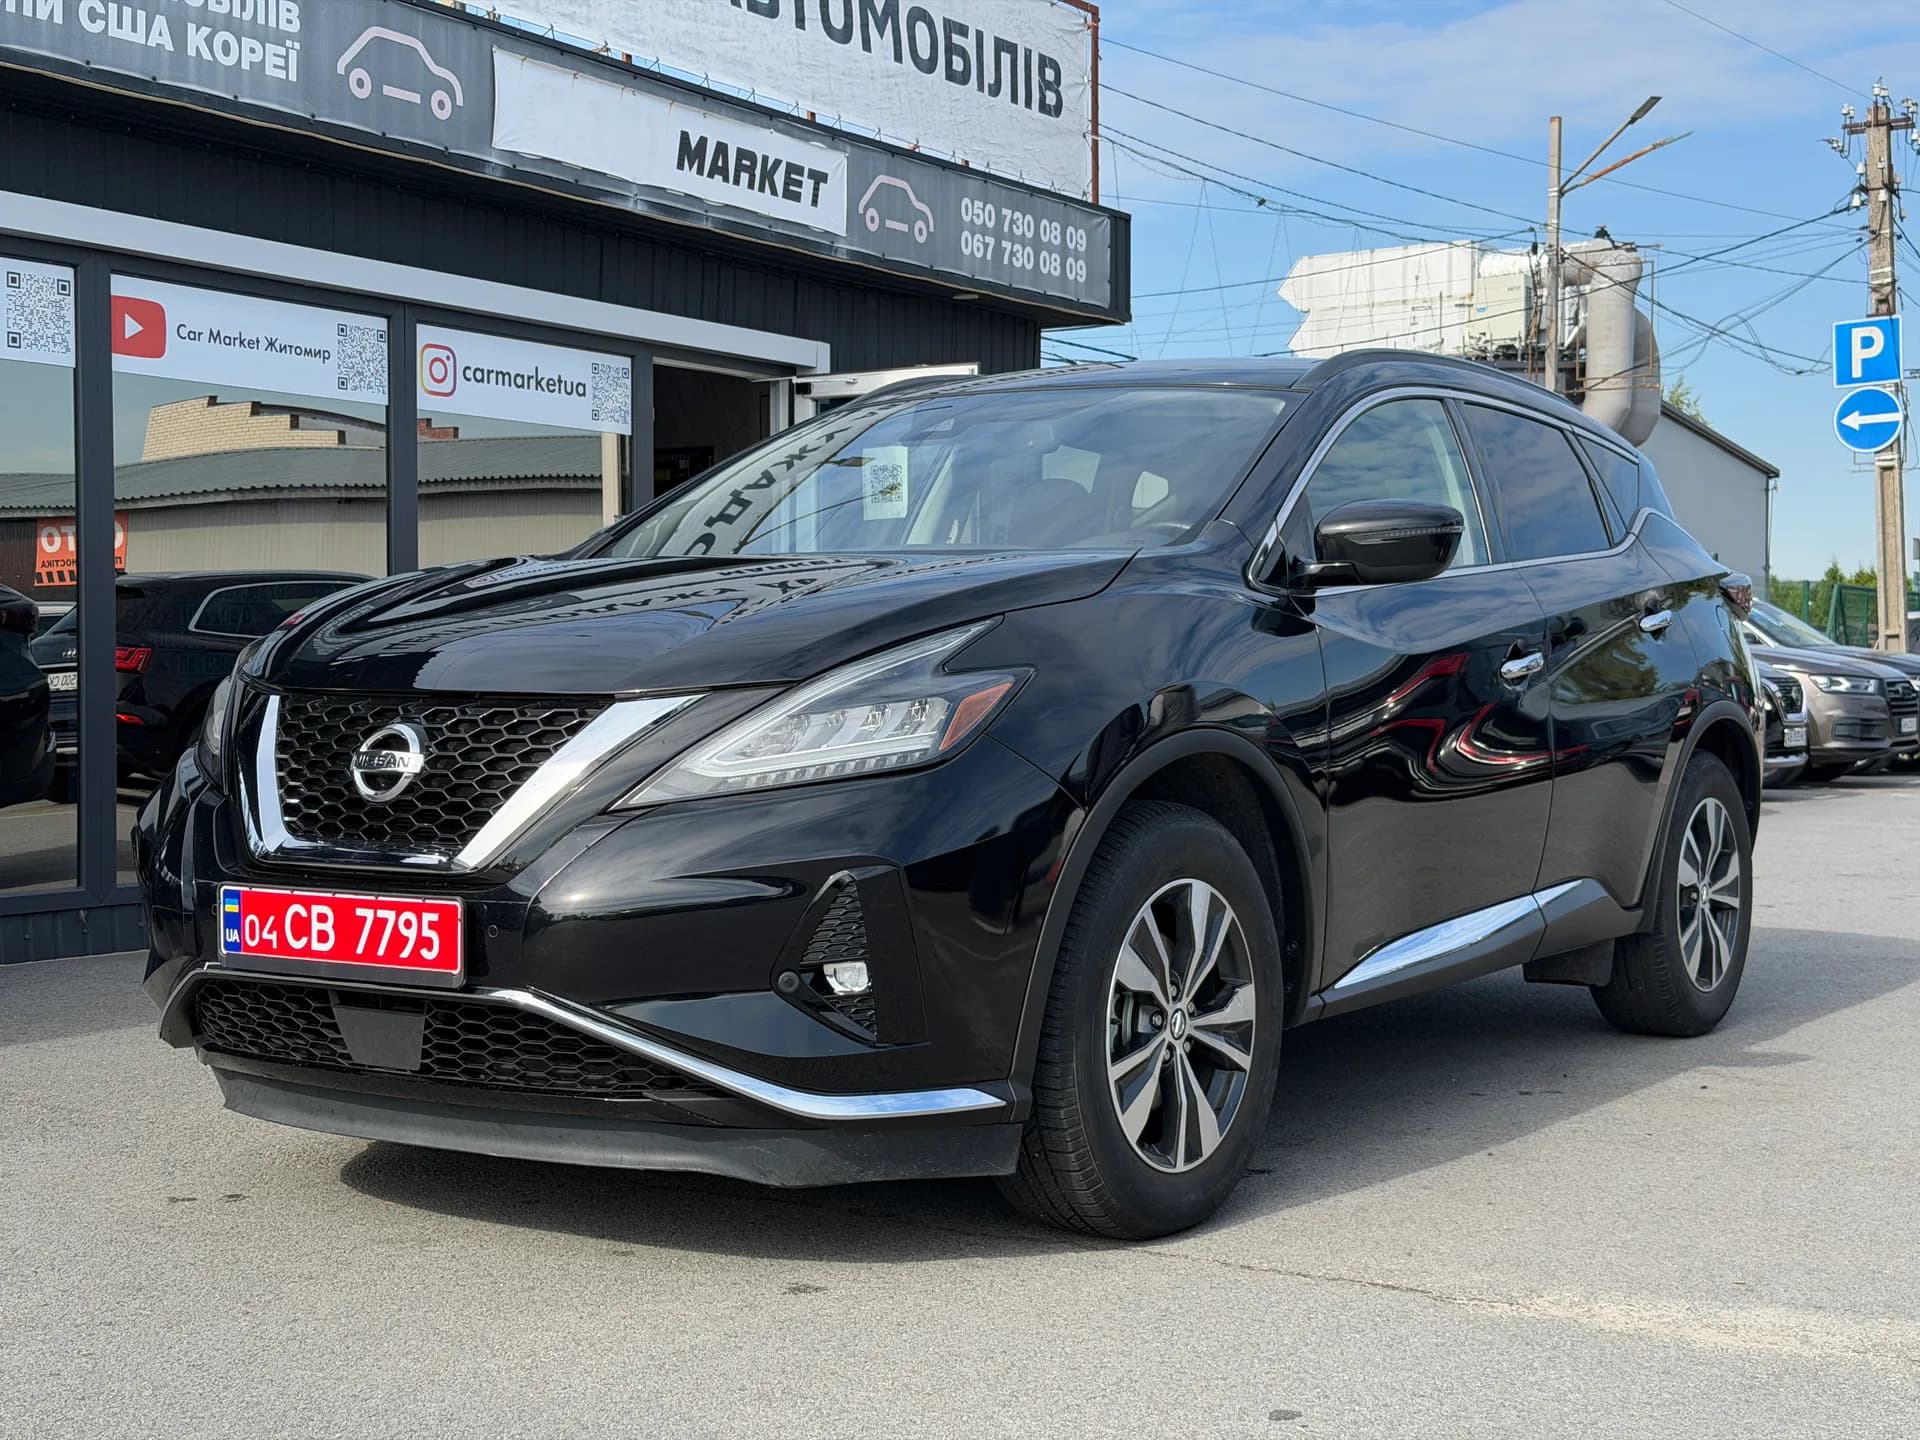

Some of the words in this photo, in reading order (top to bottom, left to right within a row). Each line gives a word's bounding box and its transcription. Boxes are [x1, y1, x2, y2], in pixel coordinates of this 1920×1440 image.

[78, 0, 174, 51] США
[187, 22, 301, 82] КОРЕЇ
[676, 129, 829, 208] MARKET
[960, 197, 996, 228] 050
[1001, 208, 1035, 239] 730
[1039, 218, 1061, 246] 08
[1066, 225, 1087, 252] 09
[960, 230, 996, 261] 067
[1001, 240, 1035, 270] 730
[1039, 250, 1061, 276] 08
[1066, 257, 1087, 283] 09
[176, 323, 204, 342] Car
[207, 328, 260, 351] Market
[264, 335, 332, 364] Житомир
[1851, 326, 1885, 378] P
[462, 365, 587, 398] carmarketua
[353, 751, 412, 769] NISSAN
[226, 928, 240, 943] UA
[244, 914, 279, 950] 04
[284, 903, 336, 952] CB
[355, 907, 440, 961] 7795
